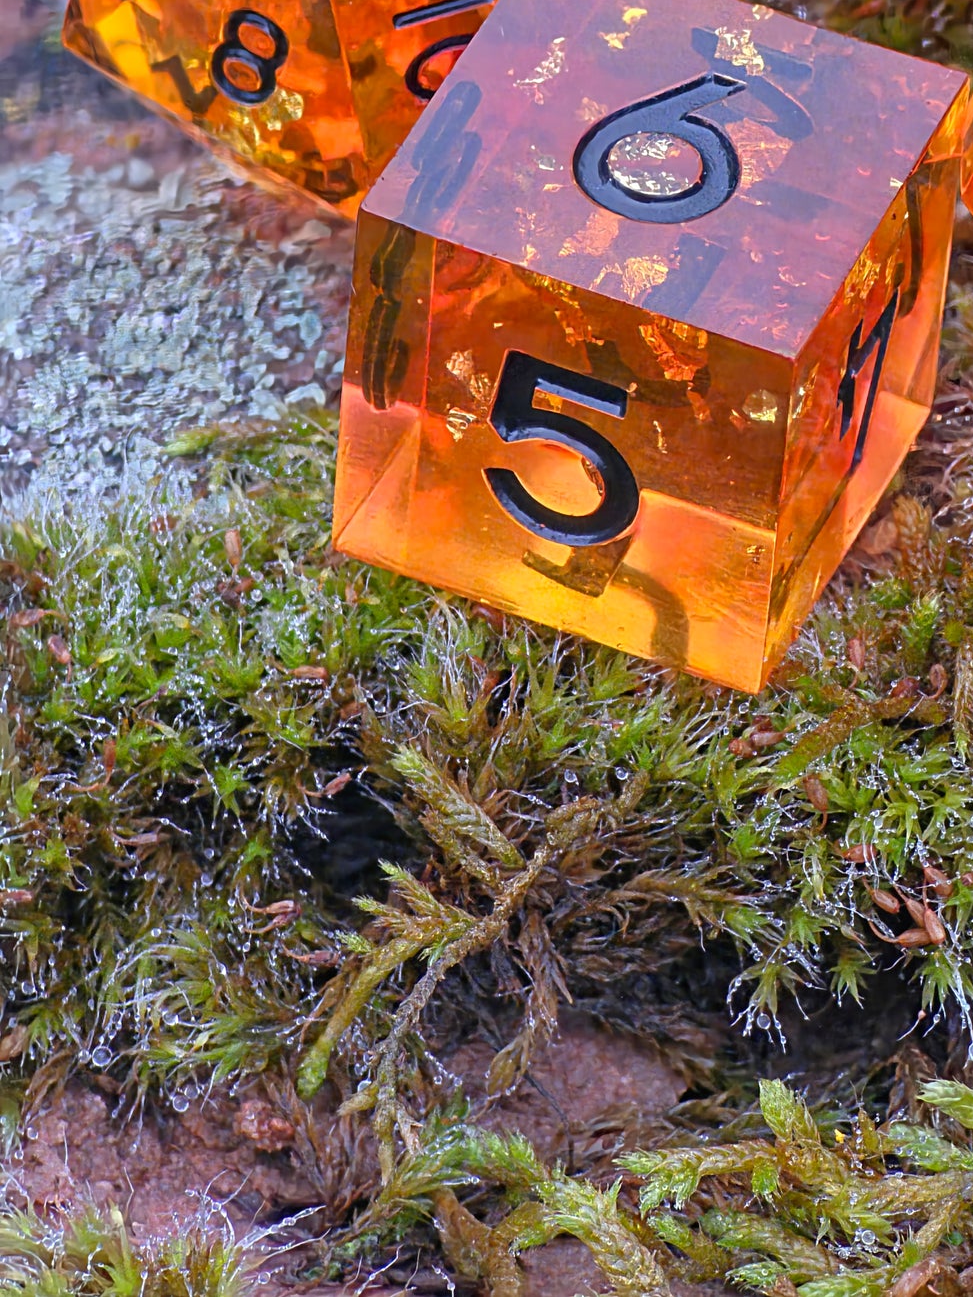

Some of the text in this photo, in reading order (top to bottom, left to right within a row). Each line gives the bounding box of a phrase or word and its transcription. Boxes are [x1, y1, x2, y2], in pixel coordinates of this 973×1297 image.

[211, 8, 289, 106] 8
[573, 71, 746, 224] 6
[482, 348, 641, 547] 5
